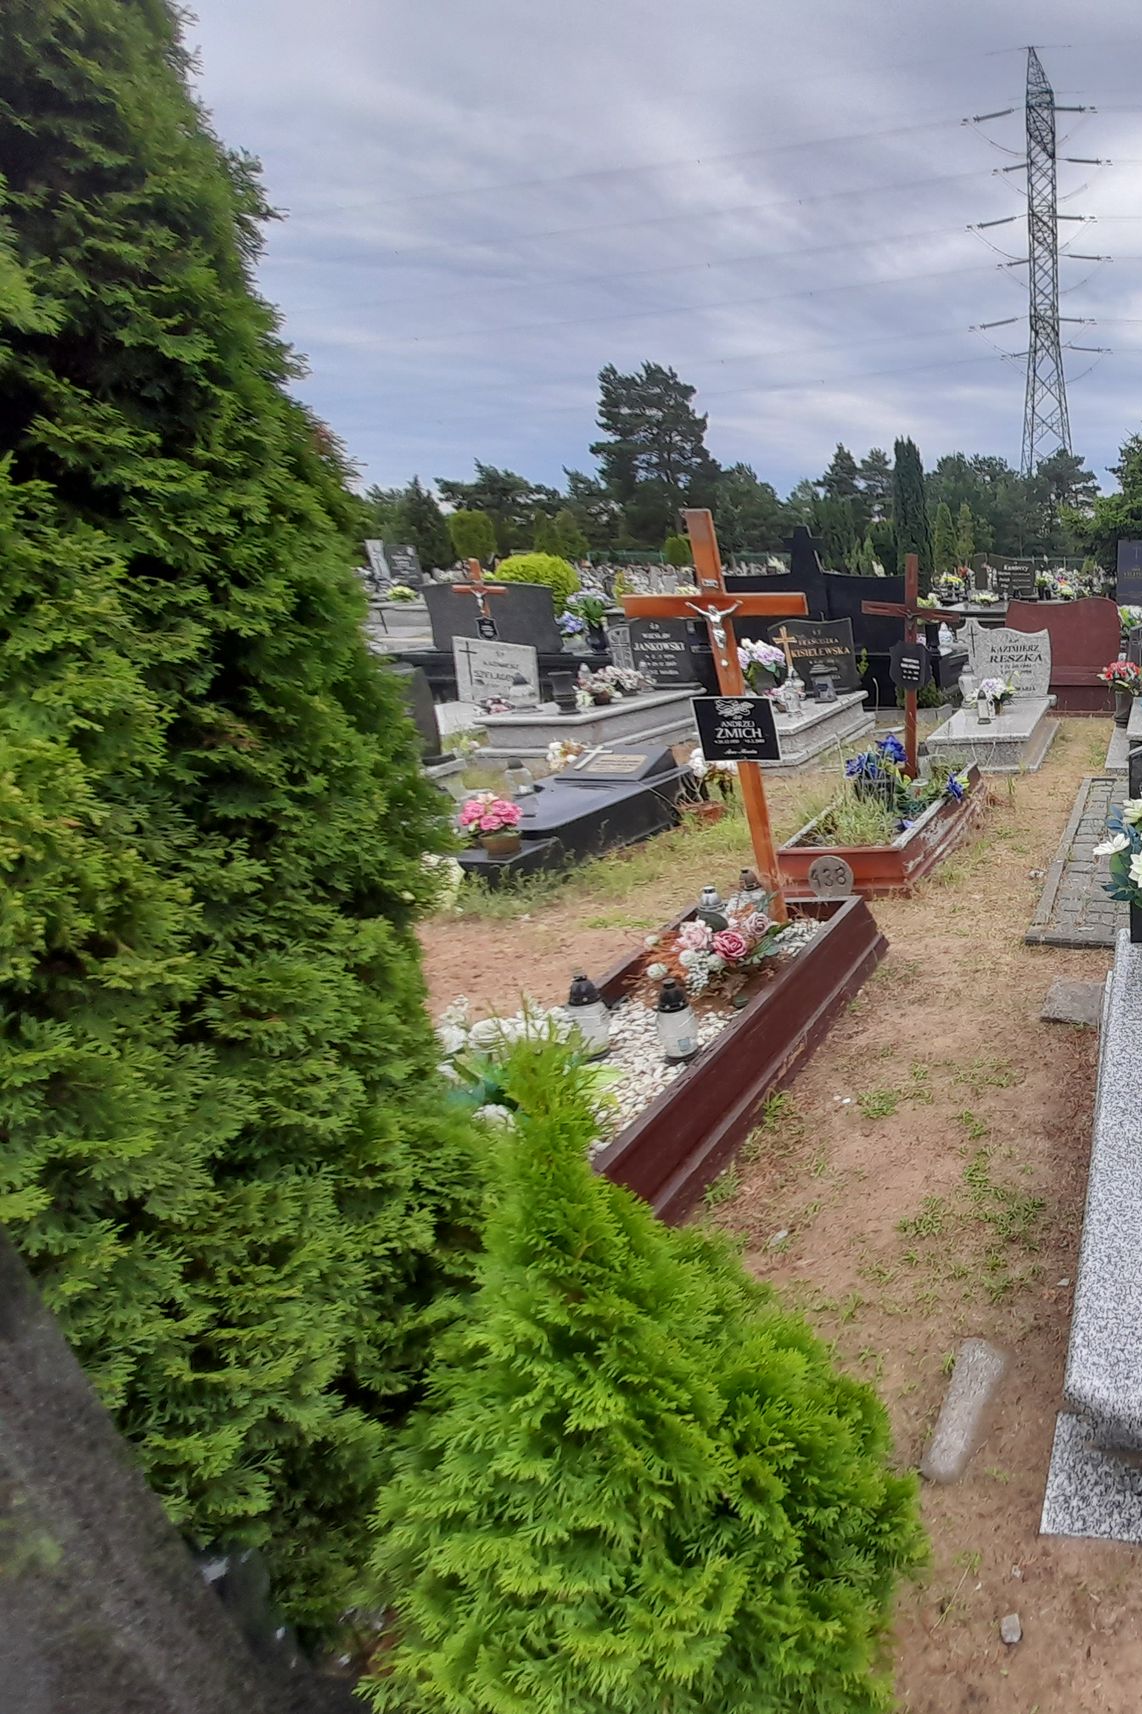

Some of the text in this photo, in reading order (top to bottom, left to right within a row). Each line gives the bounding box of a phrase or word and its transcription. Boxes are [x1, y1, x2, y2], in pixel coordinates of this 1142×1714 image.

[633, 641, 685, 651] JANKOWSKI
[990, 644, 1040, 653] KAZIMIERZ
[791, 646, 850, 658] KISIELEWSKA
[989, 653, 1042, 663] RESZKA
[720, 720, 755, 728] ANDRZEJ
